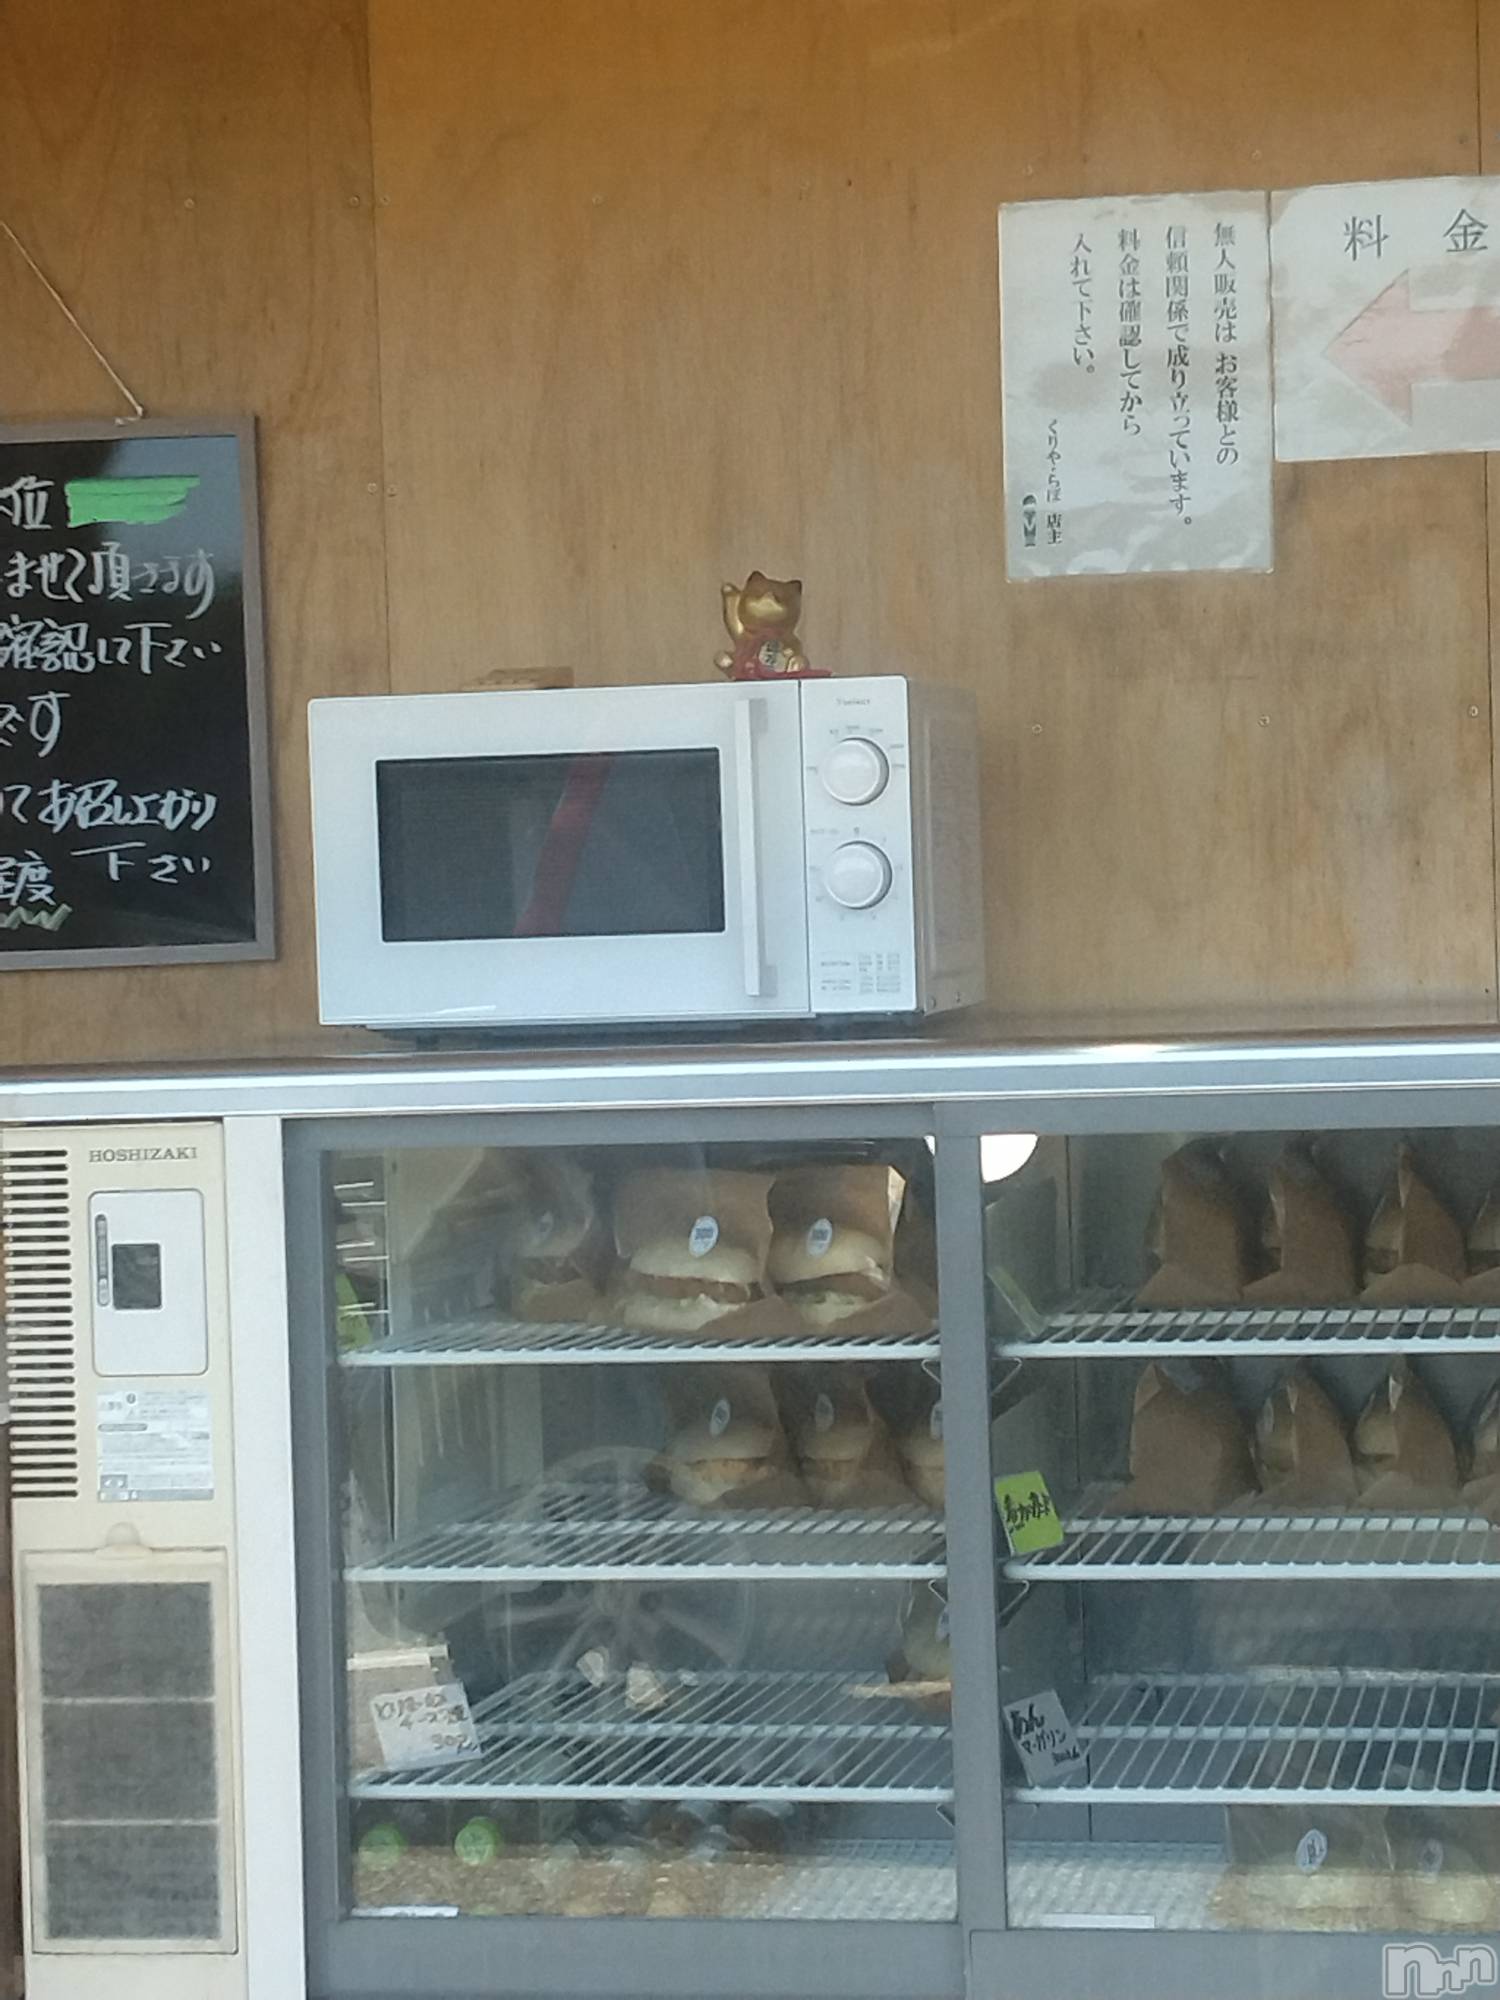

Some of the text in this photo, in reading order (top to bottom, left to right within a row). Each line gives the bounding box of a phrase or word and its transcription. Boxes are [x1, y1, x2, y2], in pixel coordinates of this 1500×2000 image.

[1069, 233, 1096, 375] 入れて下さい。
[1118, 227, 1143, 435] 料金は確認してから
[1165, 225, 1193, 526] 信頼関係で成り立っています。
[1213, 222, 1239, 466] 無人販売は お客様との
[88, 1147, 198, 1163] HOSHIZAKI
